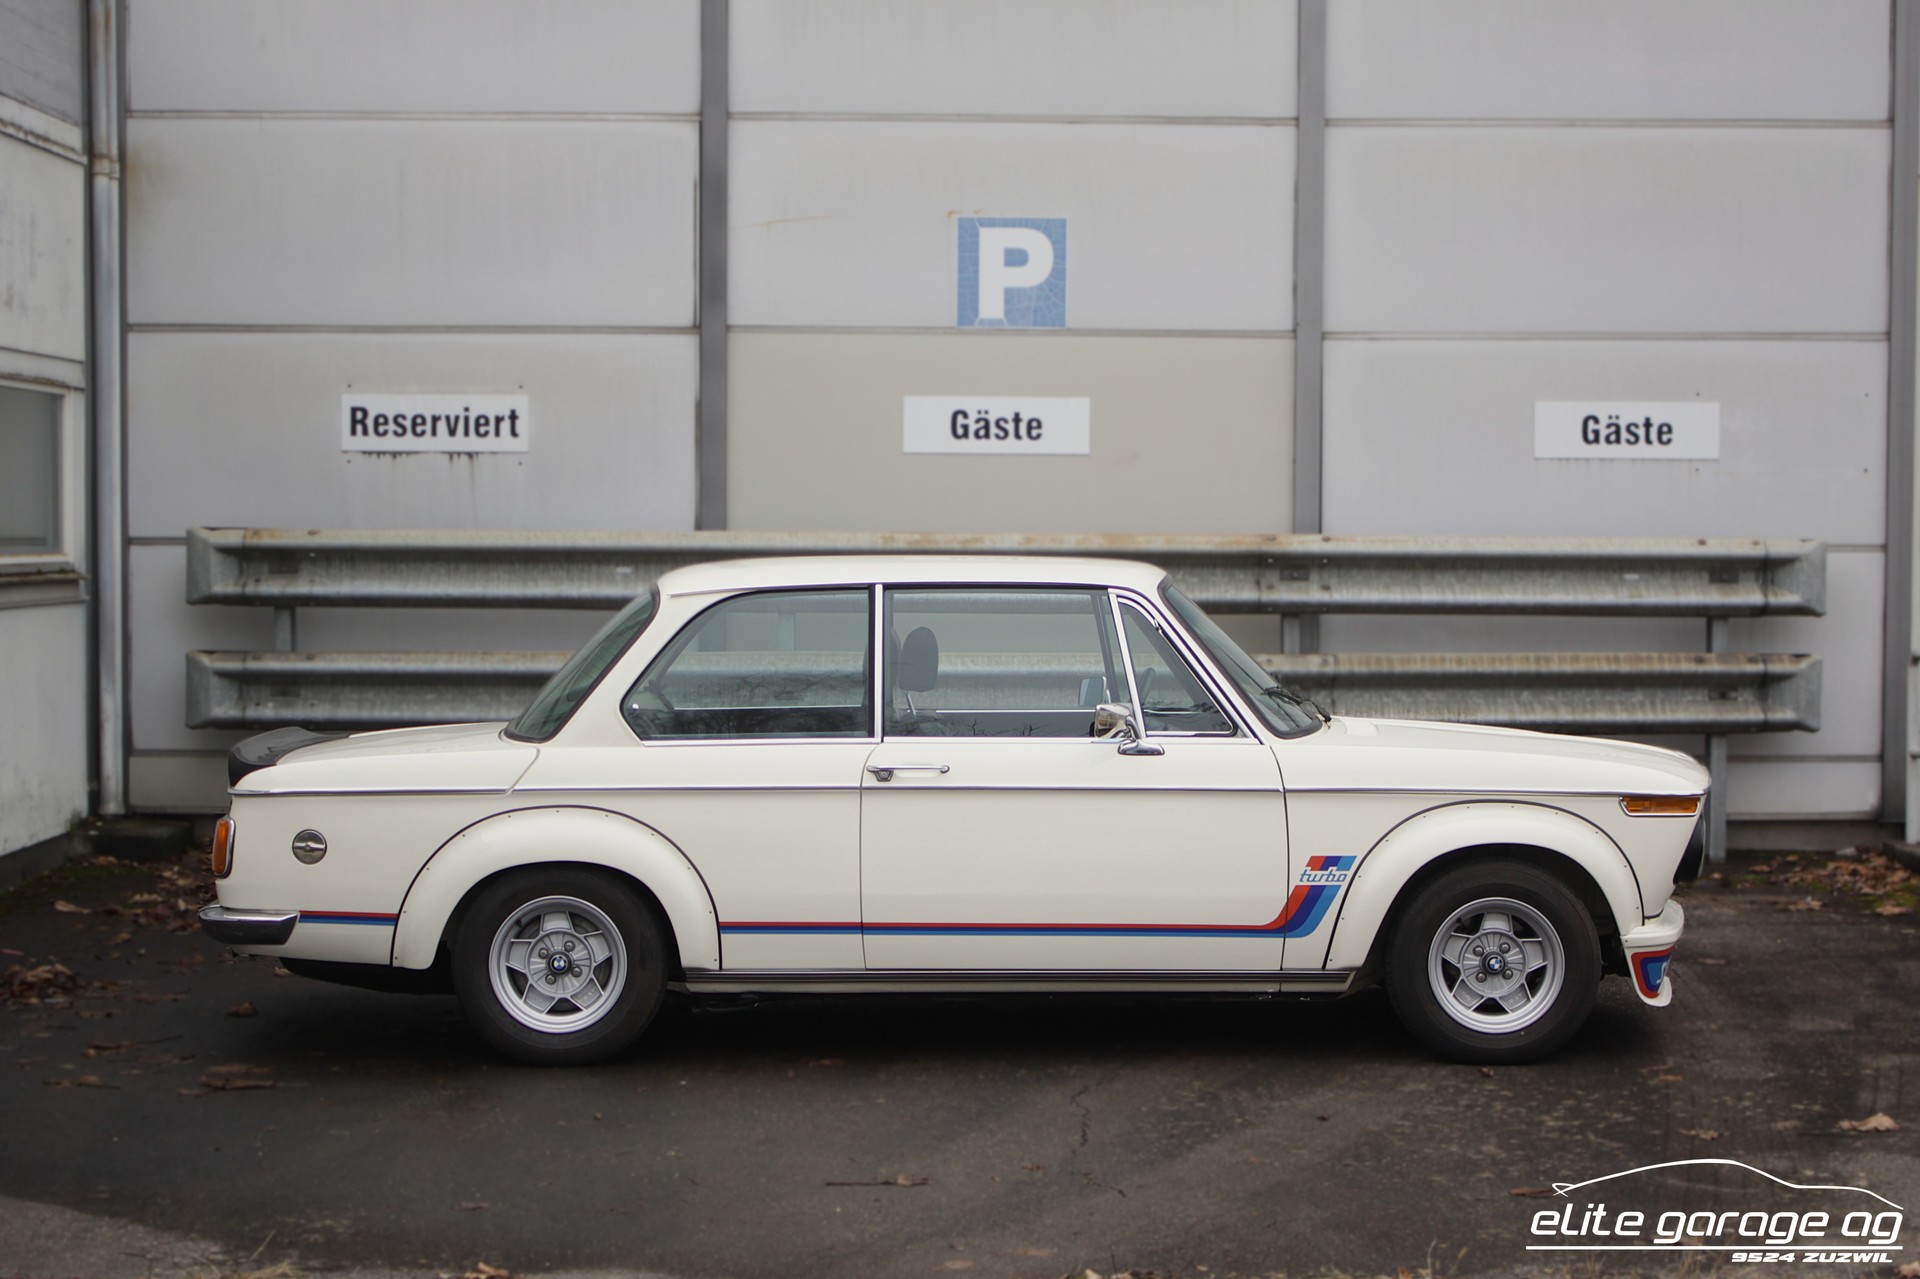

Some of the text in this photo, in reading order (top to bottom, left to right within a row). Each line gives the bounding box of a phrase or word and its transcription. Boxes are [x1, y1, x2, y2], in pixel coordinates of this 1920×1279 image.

[979, 227, 1054, 319] P
[350, 406, 519, 438] Reserviert
[950, 409, 1043, 440] Gäste
[1581, 414, 1673, 446] Gäste
[1299, 868, 1348, 883] turbo
